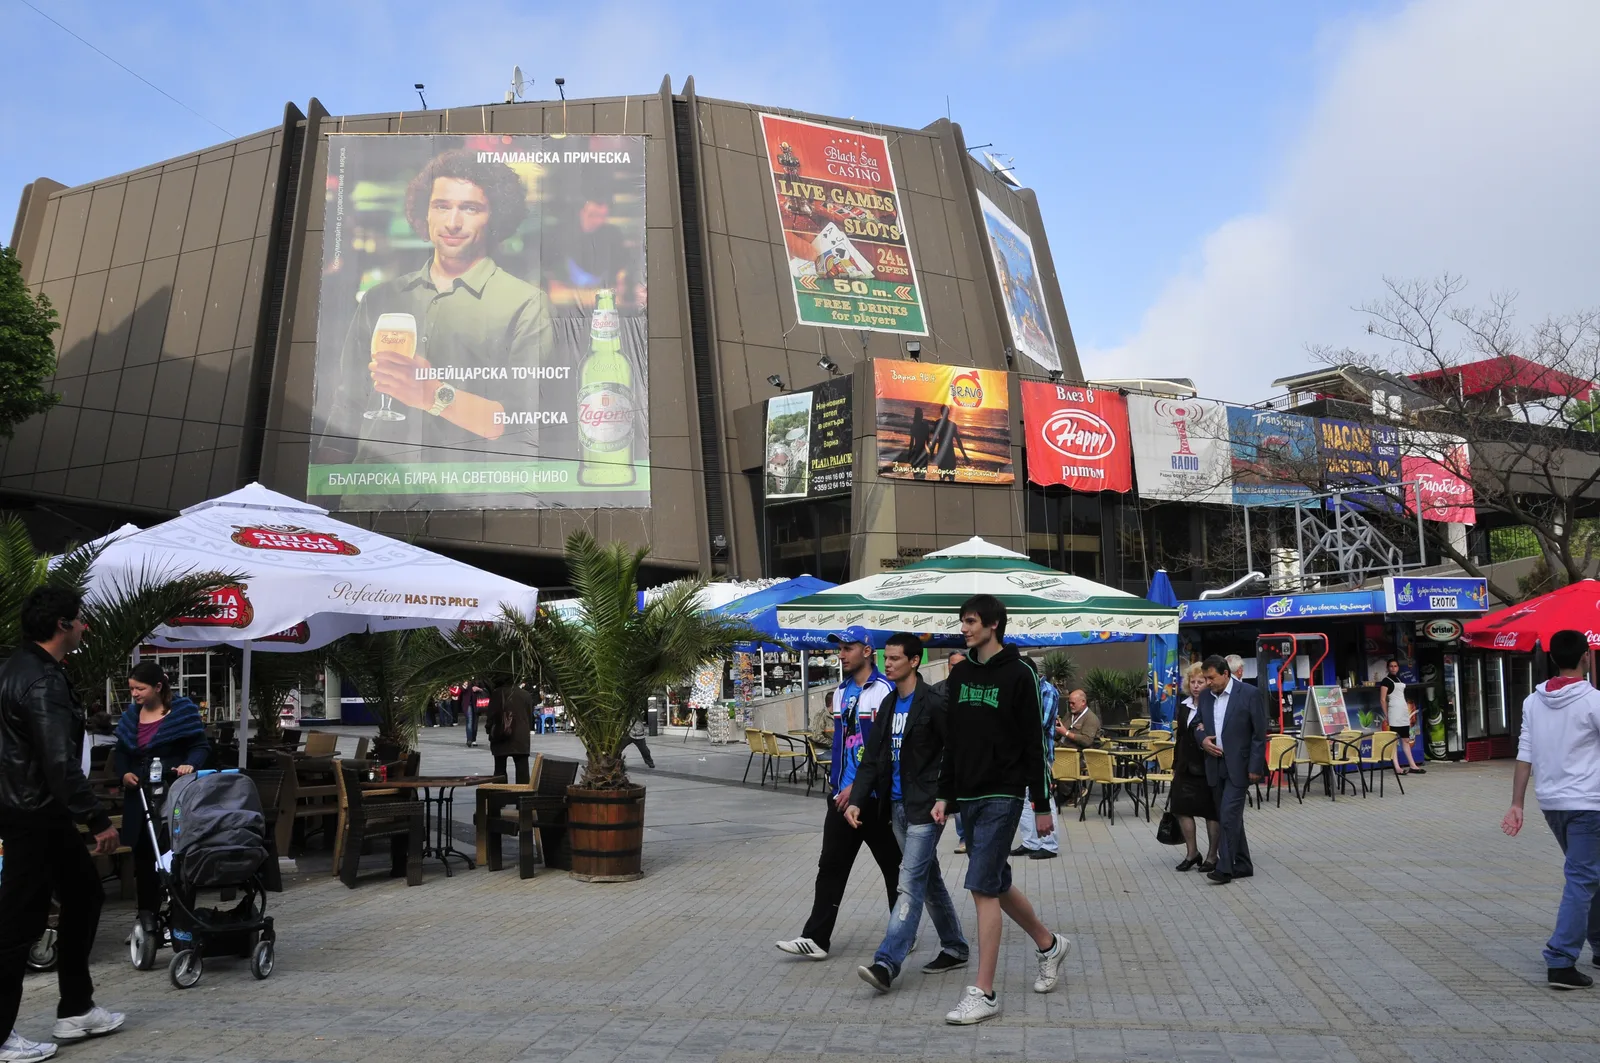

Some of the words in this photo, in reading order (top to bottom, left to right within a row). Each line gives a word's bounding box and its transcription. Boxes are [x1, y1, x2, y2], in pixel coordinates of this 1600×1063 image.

[477, 152, 560, 164] ИТАЛИАНСКА
[564, 152, 630, 164] ПРИЧЕСКА
[824, 146, 858, 164] Black
[860, 152, 878, 168] Sea
[828, 164, 881, 182] CASINO
[336, 174, 345, 216] удоволствие
[779, 180, 826, 201] LIVE
[831, 188, 895, 212] GAMES
[844, 218, 902, 241] SLOTS
[332, 222, 342, 270] Консумирайте
[877, 264, 909, 276] OPEN
[833, 279, 870, 295] 50
[814, 298, 852, 311] FREE
[858, 302, 908, 317] DRINKS
[832, 310, 850, 322] for
[854, 313, 897, 327] players
[415, 366, 508, 380] ШВЕЙЦАРСКА
[512, 367, 570, 380] ТОЧНОСТ
[1056, 386, 1084, 402] Влез
[493, 412, 568, 425] БЪЛГАРСКА
[1052, 419, 1108, 454] Happy
[1171, 456, 1199, 471] RADIO
[328, 472, 401, 486] БЪЛГАРСКА
[404, 472, 438, 486] БИРА
[441, 472, 459, 484] НА
[462, 471, 530, 484] СВЕТОВНО
[533, 470, 568, 483] НИВО
[1062, 464, 1105, 481] ритъм
[252, 532, 329, 544] STELLA
[258, 539, 339, 552] ARTOIS
[176, 534, 286, 562] ANNO
[341, 550, 406, 566] 1366
[328, 581, 402, 606] Perfection
[404, 594, 428, 606] HAS
[430, 595, 447, 606] ITS
[448, 596, 479, 608] PRICE
[1432, 597, 1456, 608] EXOTIC
[1268, 605, 1292, 614] NESTEA
